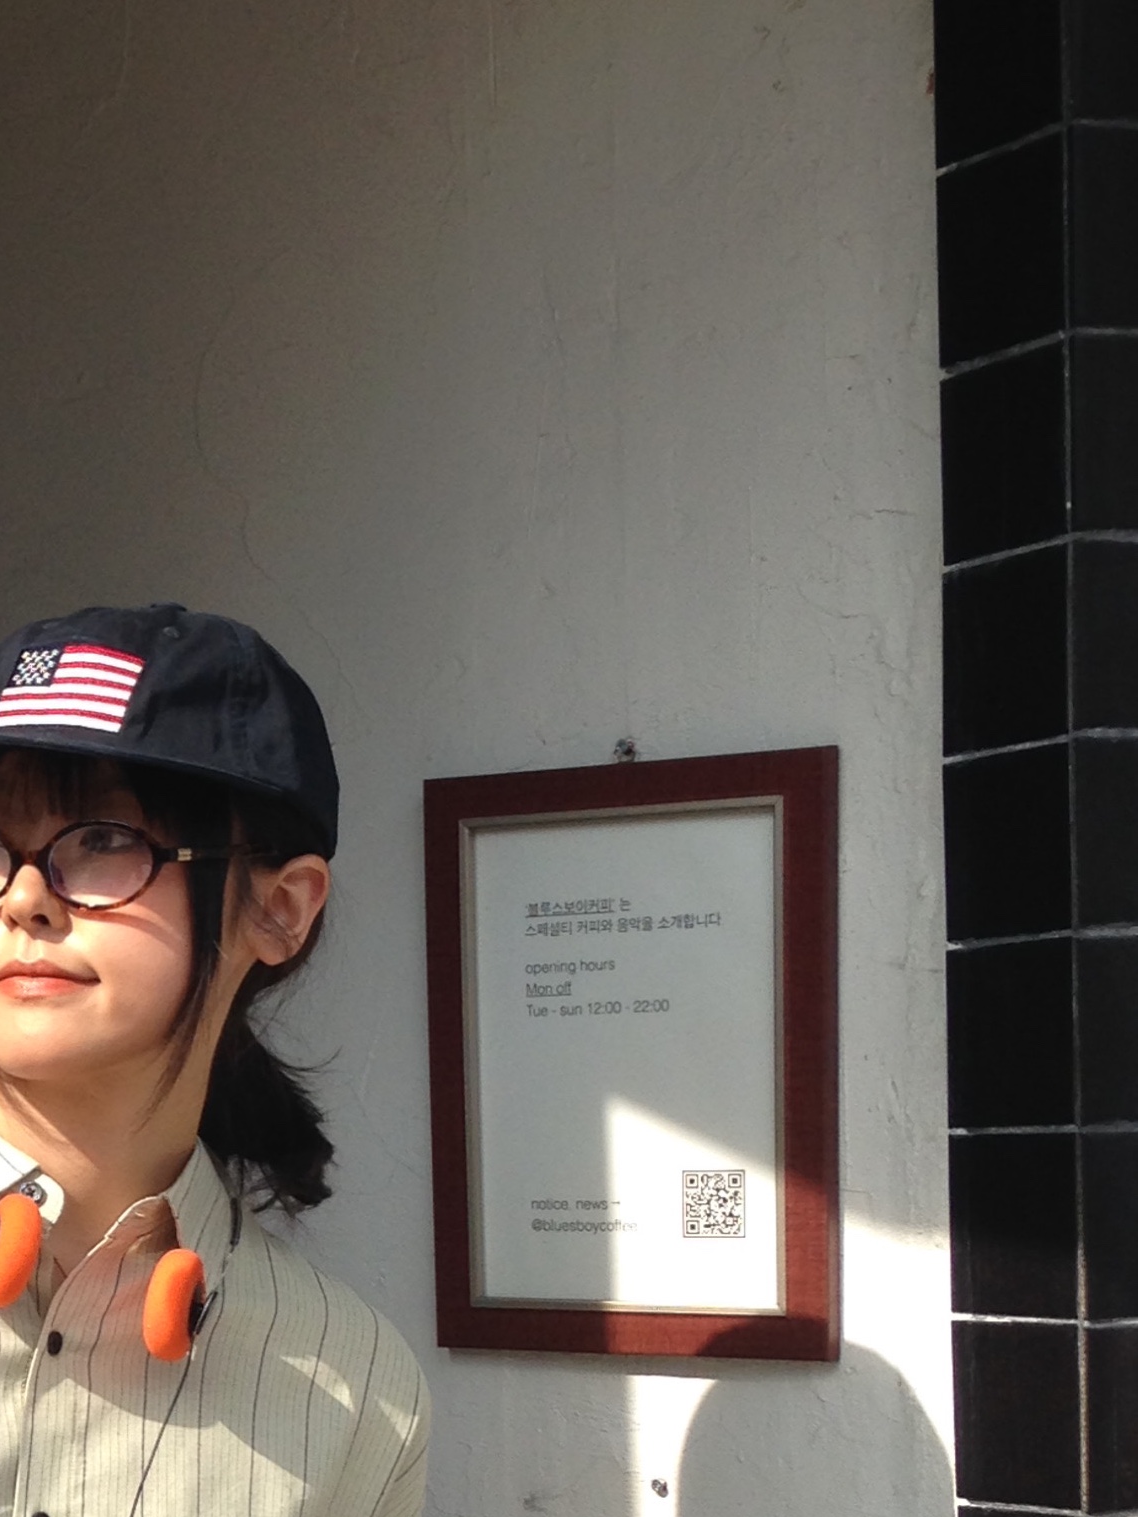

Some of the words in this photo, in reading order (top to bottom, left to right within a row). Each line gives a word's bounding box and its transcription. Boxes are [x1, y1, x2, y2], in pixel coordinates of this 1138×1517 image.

[618, 897, 631, 912] 는
[576, 919, 612, 934] 커피와
[617, 916, 653, 933] 음악을
[525, 961, 576, 976] opening
[580, 959, 616, 971] hours
[526, 983, 553, 997] Mon
[556, 981, 572, 996] off
[526, 1004, 548, 1017] Tue
[559, 1005, 583, 1016] sun
[587, 1001, 622, 1015] 12:00
[633, 999, 670, 1013] 22:00
[575, 1200, 608, 1211] news
